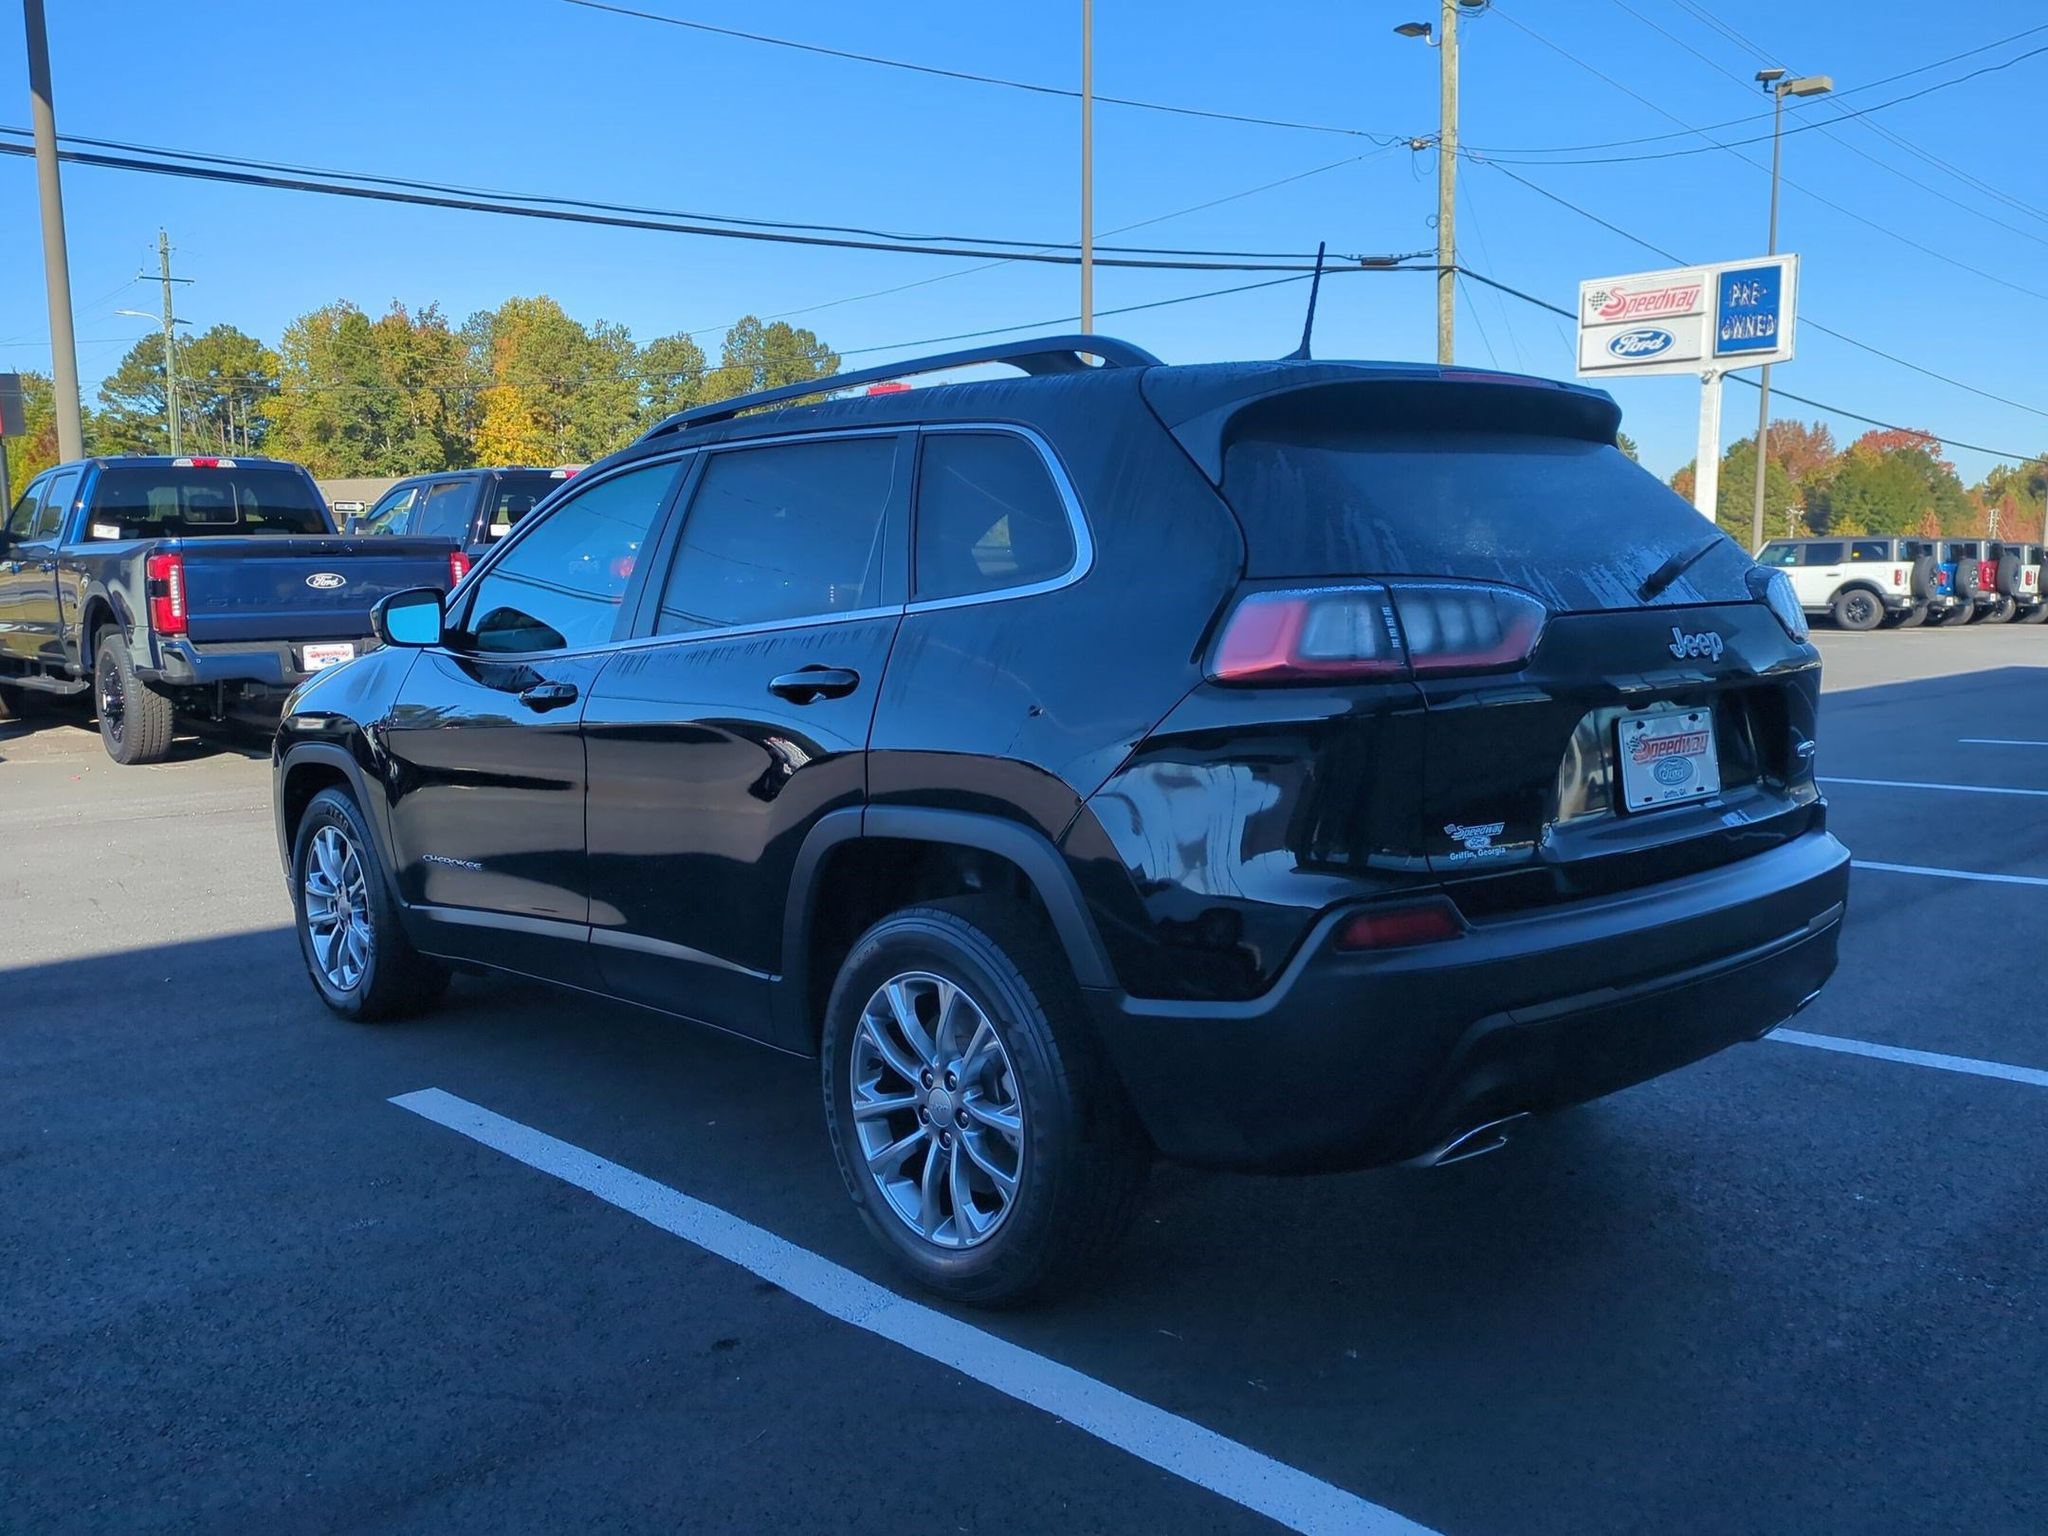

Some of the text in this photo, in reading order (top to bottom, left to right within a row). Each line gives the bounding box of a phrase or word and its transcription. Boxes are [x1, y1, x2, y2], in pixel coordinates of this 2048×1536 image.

[1598, 286, 1701, 320] Speedway
[1722, 315, 1776, 341] OWNED
[1613, 331, 1666, 354] Ford
[312, 574, 340, 587] Ford
[1669, 627, 1723, 662] Jeep
[1451, 822, 1505, 840] Speedway
[1449, 848, 1506, 861] Griffin, Georgia
